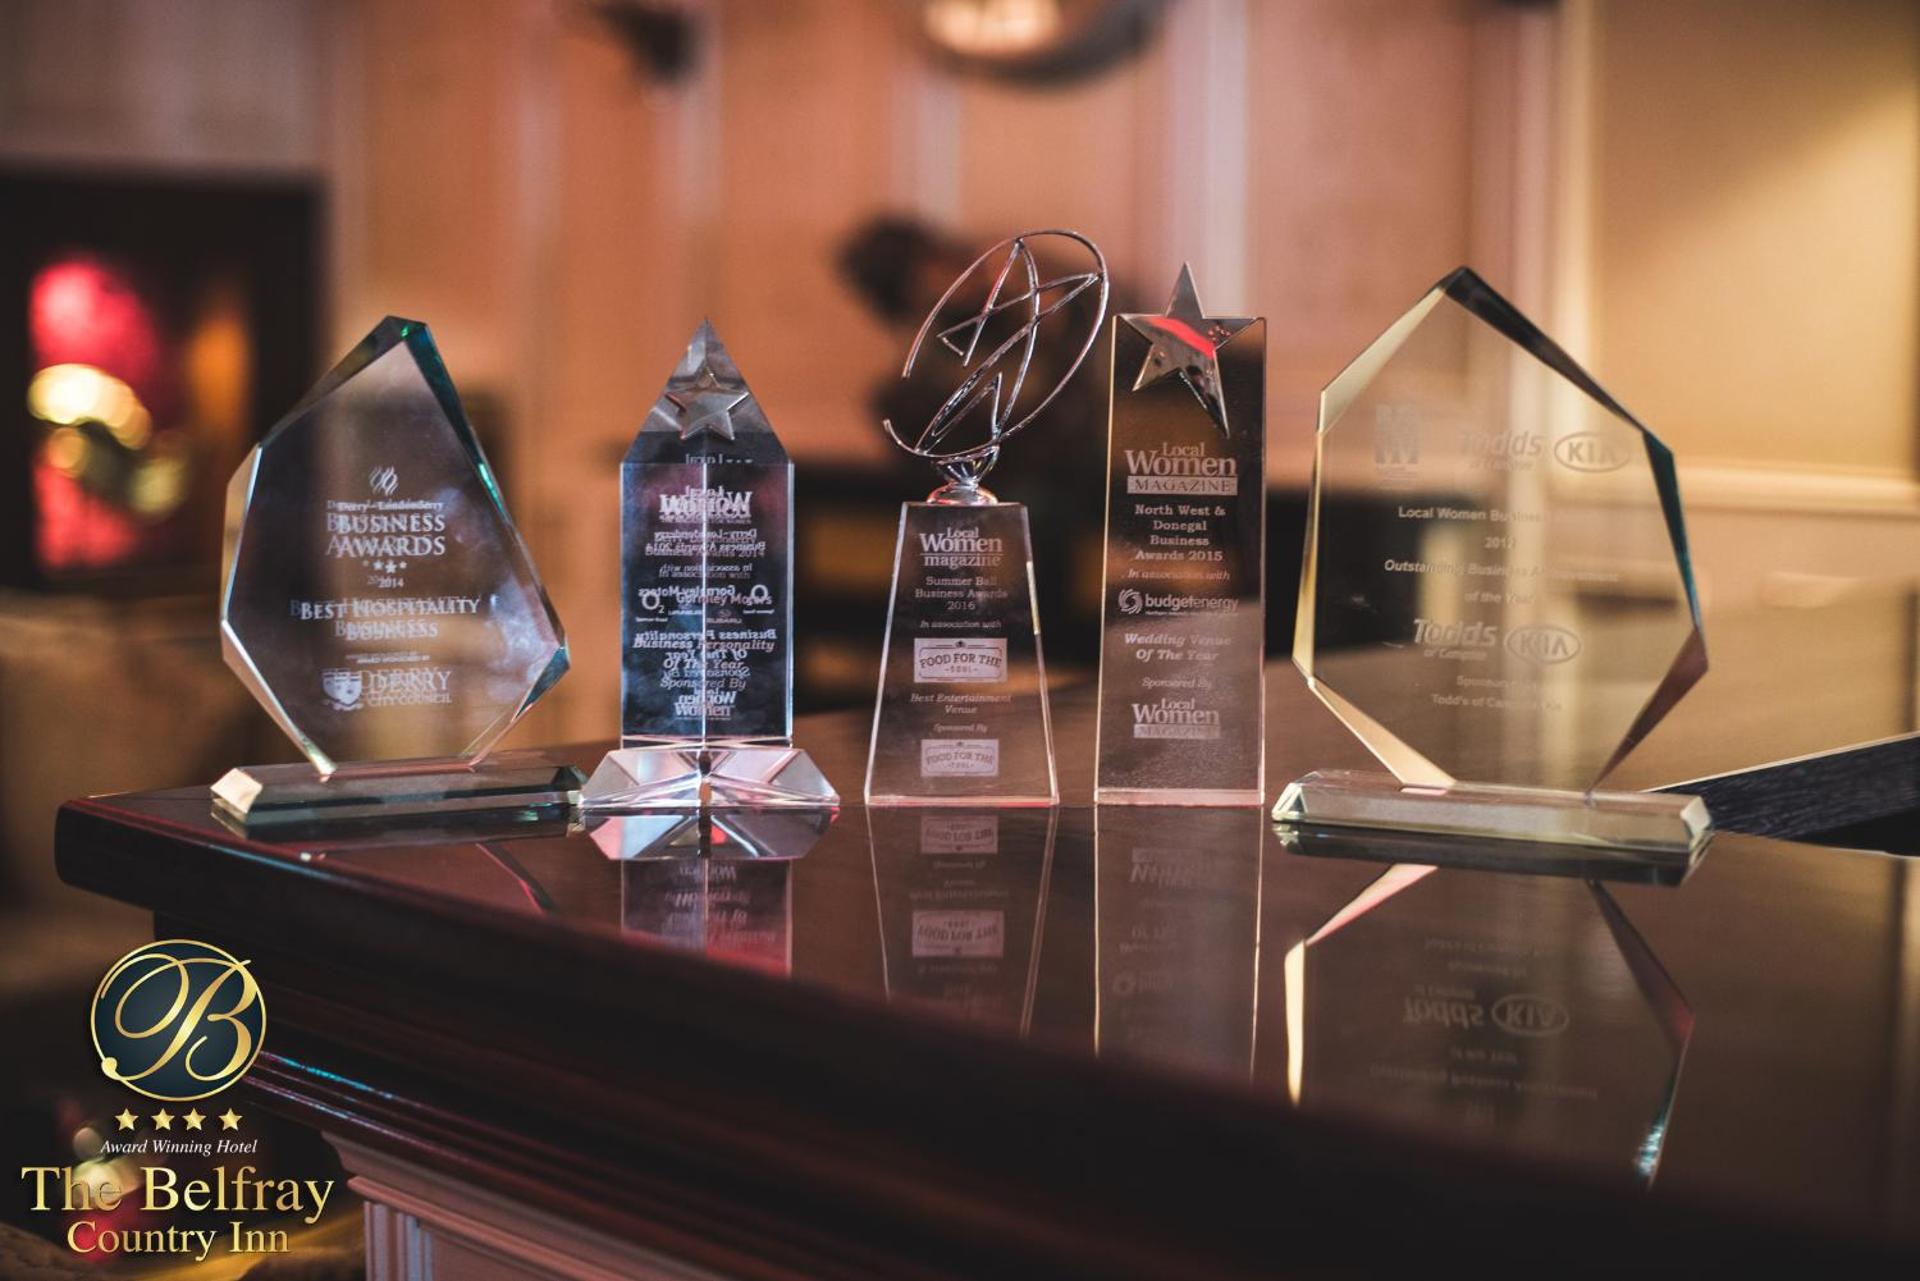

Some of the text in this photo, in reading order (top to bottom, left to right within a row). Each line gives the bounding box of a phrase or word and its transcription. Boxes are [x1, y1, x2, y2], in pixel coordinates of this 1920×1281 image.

[1163, 441, 1206, 457] Local
[1124, 450, 1238, 477] Women
[1134, 478, 1232, 493] MAGAZINE
[1134, 504, 1174, 516] North
[1178, 504, 1210, 517] West
[1398, 506, 1434, 519] Local
[1437, 507, 1487, 521] Women
[337, 513, 445, 534] BUSINESS
[1153, 520, 1208, 533] Donegal
[946, 527, 979, 538] Local
[336, 535, 446, 558] AWARDS
[919, 532, 1003, 553] Women
[1150, 535, 1210, 547] Business
[923, 554, 1001, 570] magazine
[1135, 550, 1224, 562] Awards 2015
[925, 576, 973, 586] Summer
[915, 588, 965, 599] Business
[947, 601, 976, 611] 2016
[1145, 593, 1239, 610] budgetenergy
[1124, 632, 1232, 648] Wedding Venue
[1414, 618, 1569, 658] Todds KIA
[919, 652, 1002, 670] FOOD FOR THE
[1135, 648, 1220, 663] Of The Year
[1161, 698, 1196, 710] Local
[1131, 703, 1221, 725] Women
